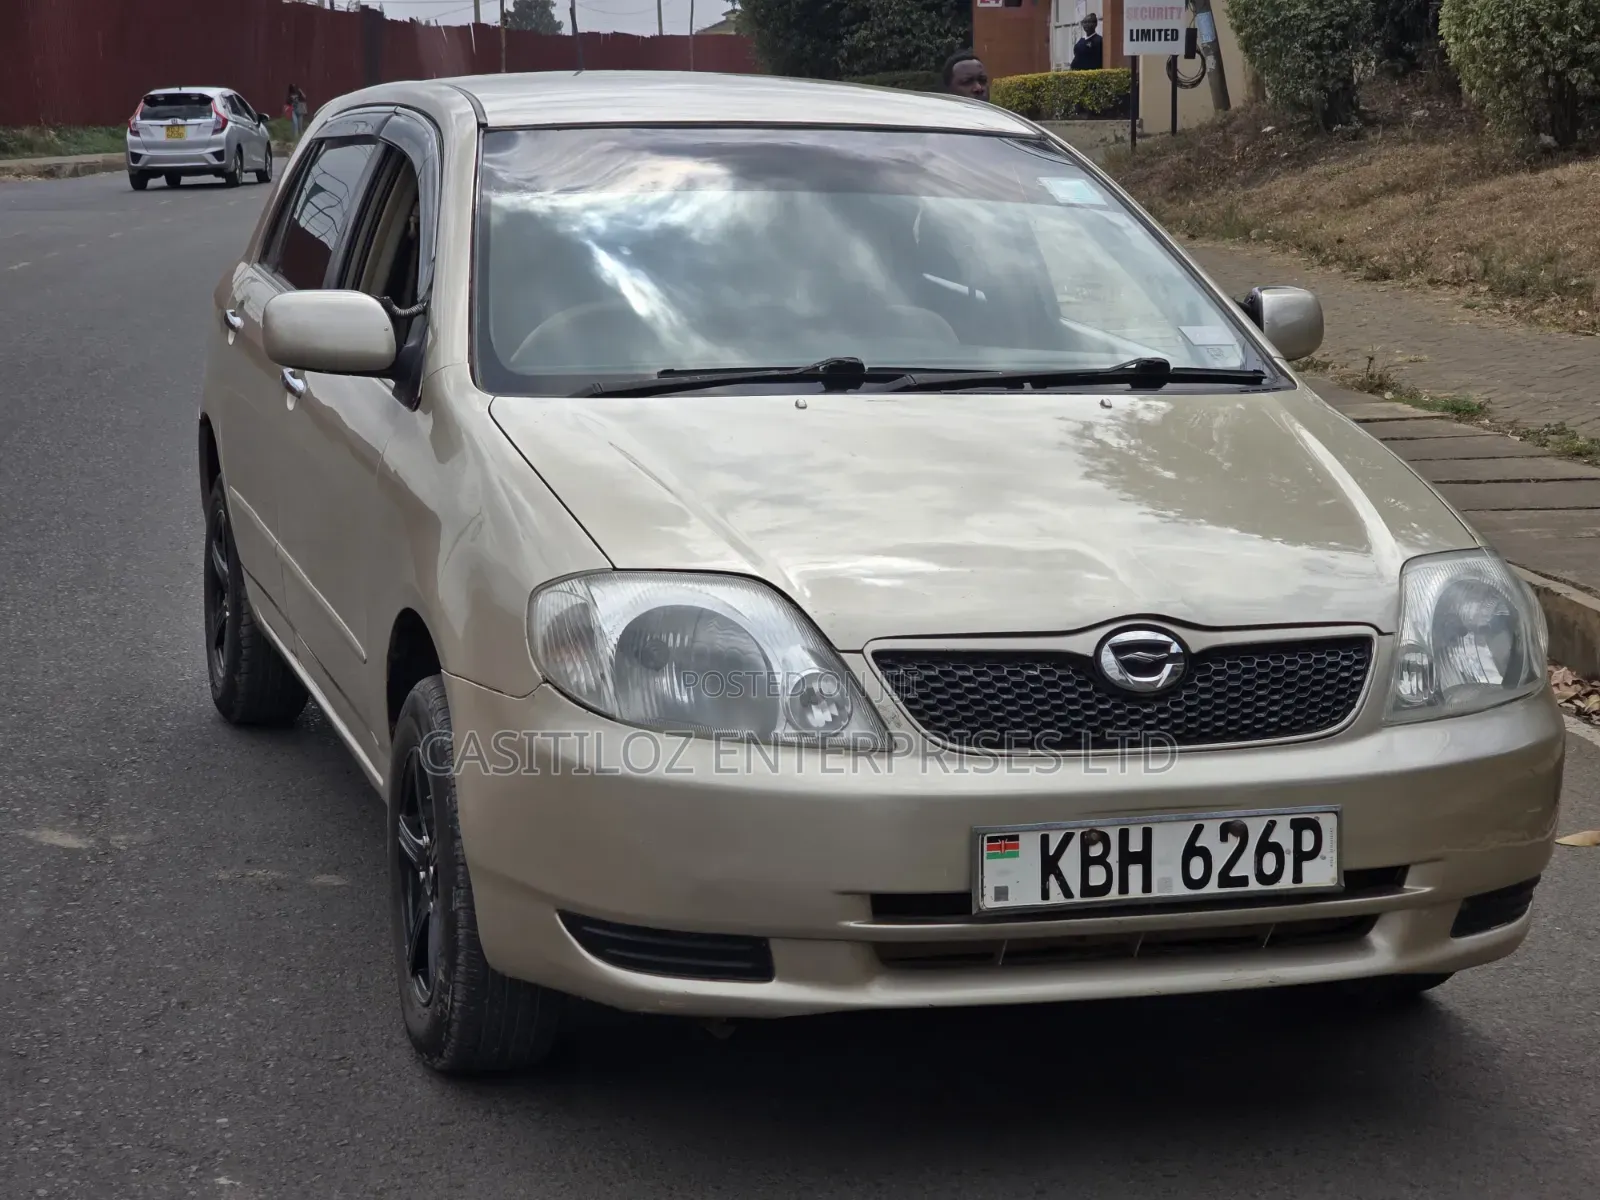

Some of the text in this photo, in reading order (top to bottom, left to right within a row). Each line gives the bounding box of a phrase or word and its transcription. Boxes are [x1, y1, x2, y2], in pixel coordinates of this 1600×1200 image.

[1126, 6, 1183, 21] SECURITY
[1129, 28, 1179, 42] LIMITED
[1040, 826, 1153, 901] KBH
[1181, 817, 1324, 891] 626P
